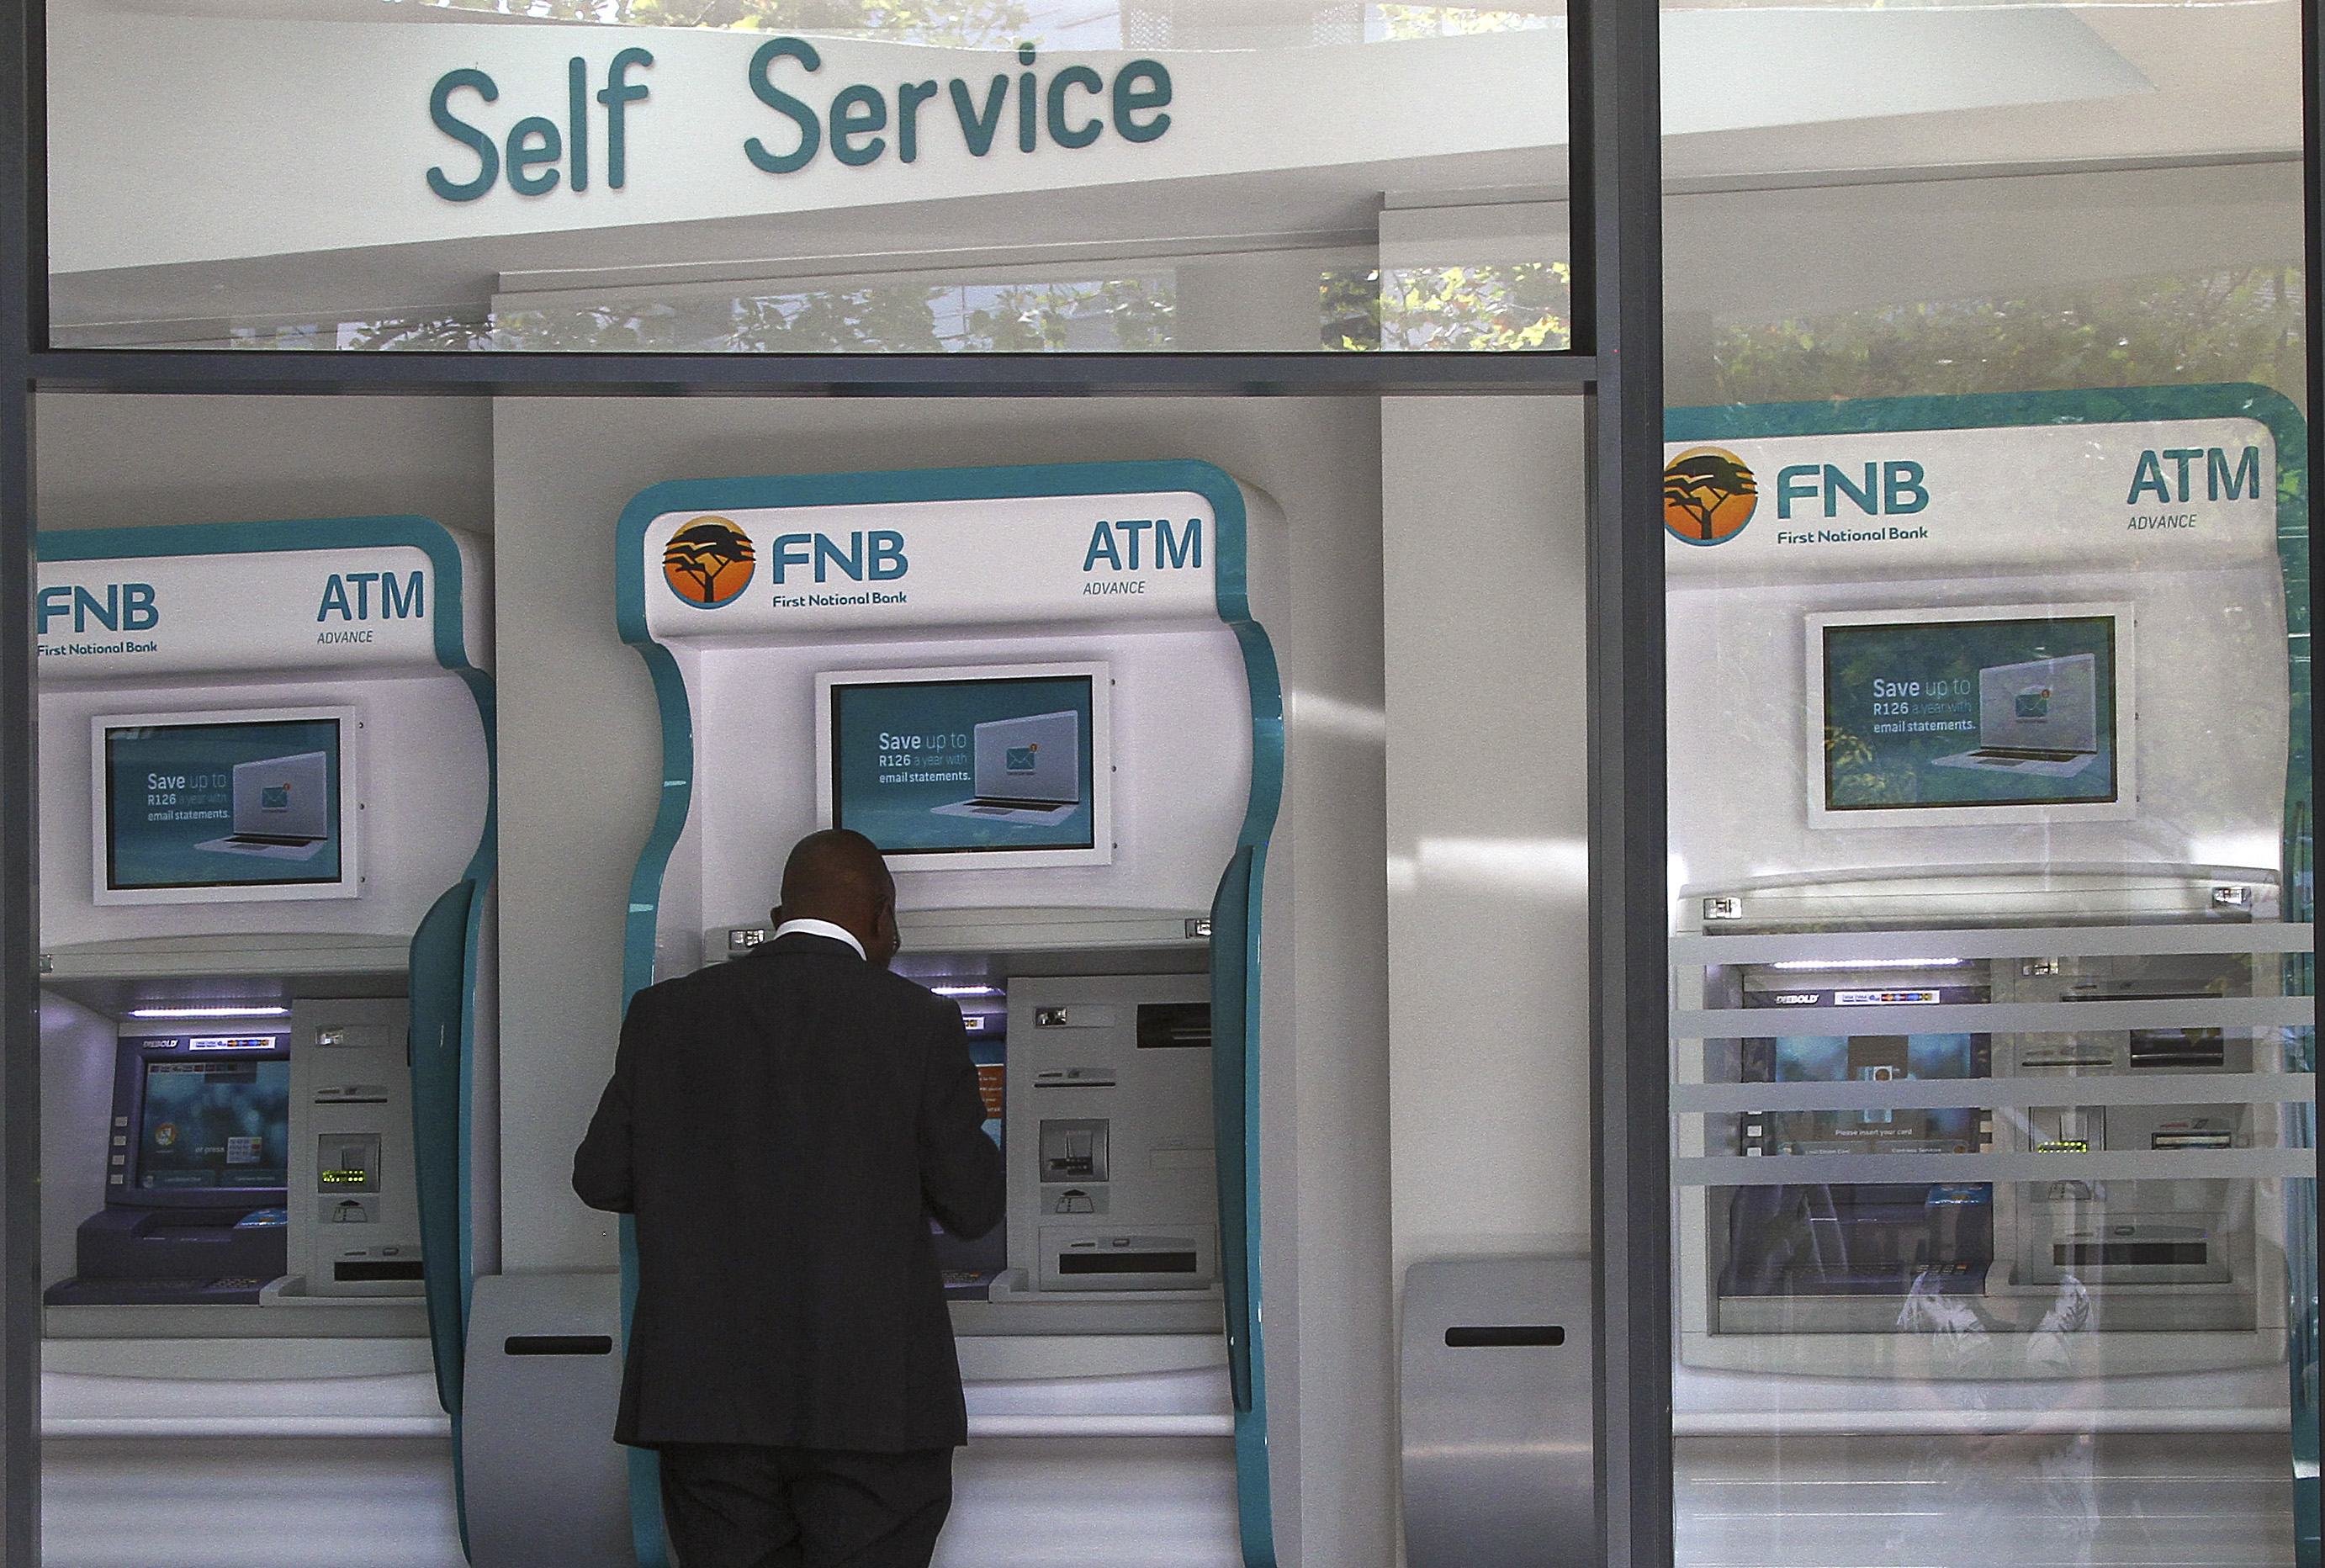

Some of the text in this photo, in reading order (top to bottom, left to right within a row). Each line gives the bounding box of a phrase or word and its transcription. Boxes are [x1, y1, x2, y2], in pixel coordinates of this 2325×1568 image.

[426, 36, 1173, 202] Self Service
[2126, 446, 2259, 505] ATM
[1777, 460, 1929, 519] FNB
[2126, 514, 2197, 530] ADVANCE
[1777, 526, 1928, 544] First National Bank
[1083, 518, 1202, 572] ATM
[772, 530, 908, 585] FNB
[1083, 580, 1146, 595] ADVANCE
[317, 570, 424, 622] ATM
[773, 591, 907, 607] First National Bank
[37, 583, 160, 634] FNB
[317, 630, 373, 644] ADVANCE
[37, 640, 157, 656] First National Bank
[1872, 678, 1971, 699] Save up to
[1873, 702, 1909, 715] R126
[1873, 719, 1977, 734] email statements.
[879, 732, 967, 753] Save up to
[879, 755, 911, 766] R126
[922, 755, 944, 768] year
[945, 753, 967, 765] with
[147, 773, 226, 792] Save up to
[879, 771, 971, 783] email statements.
[147, 794, 177, 806] R126
[147, 808, 230, 822] email statements.
[1880, 1129, 1896, 1137] your
